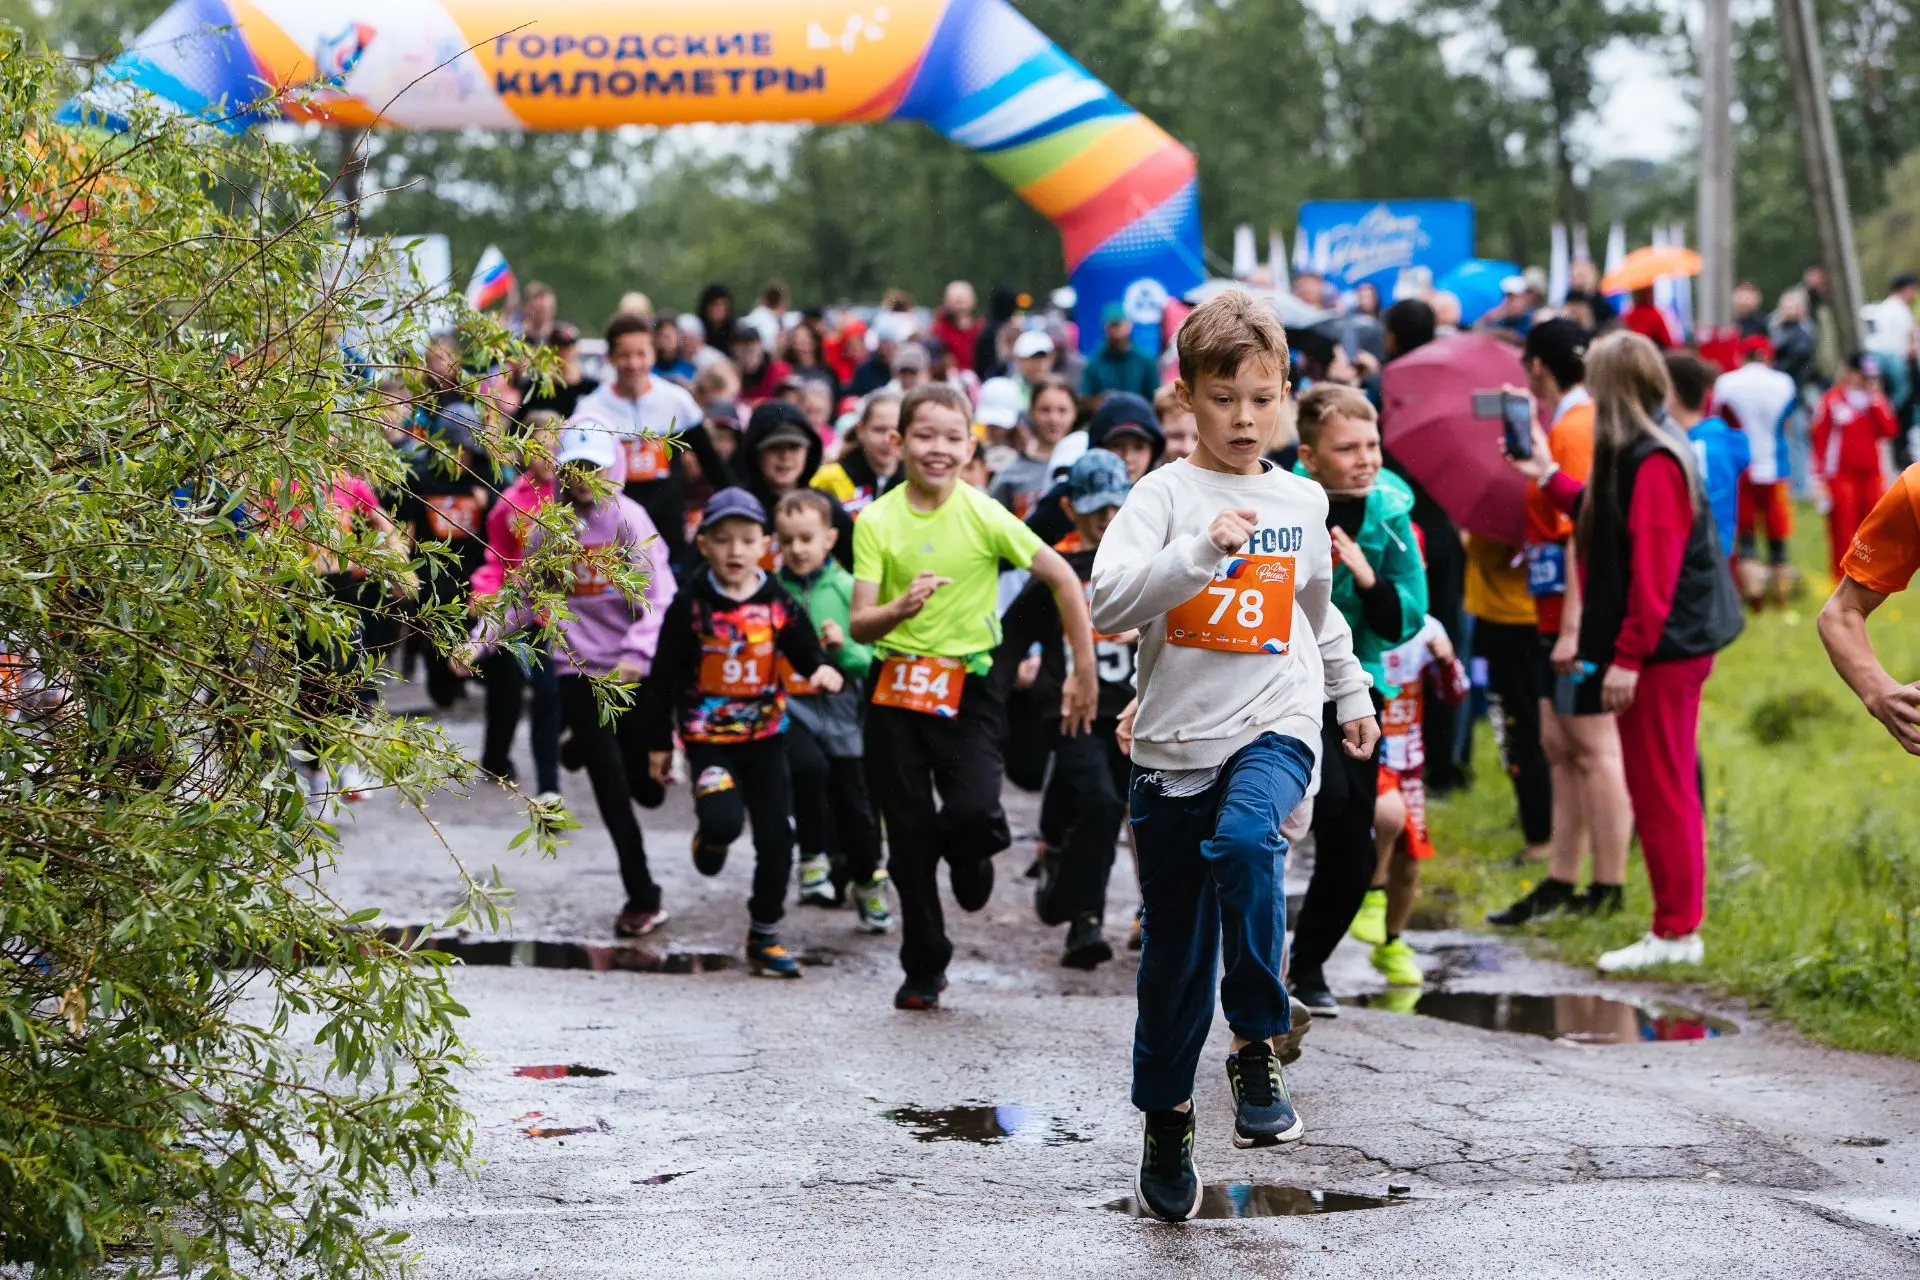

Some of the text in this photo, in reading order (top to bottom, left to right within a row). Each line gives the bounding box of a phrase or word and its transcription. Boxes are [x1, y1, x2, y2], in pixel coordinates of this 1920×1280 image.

[496, 31, 772, 61] ГОРОДСКИЕ
[496, 65, 826, 97] КИЛОМЕТРЫ
[1248, 525, 1303, 554] FOOD
[1207, 586, 1265, 629] 78
[722, 659, 762, 684] 91
[891, 662, 950, 701] 154
